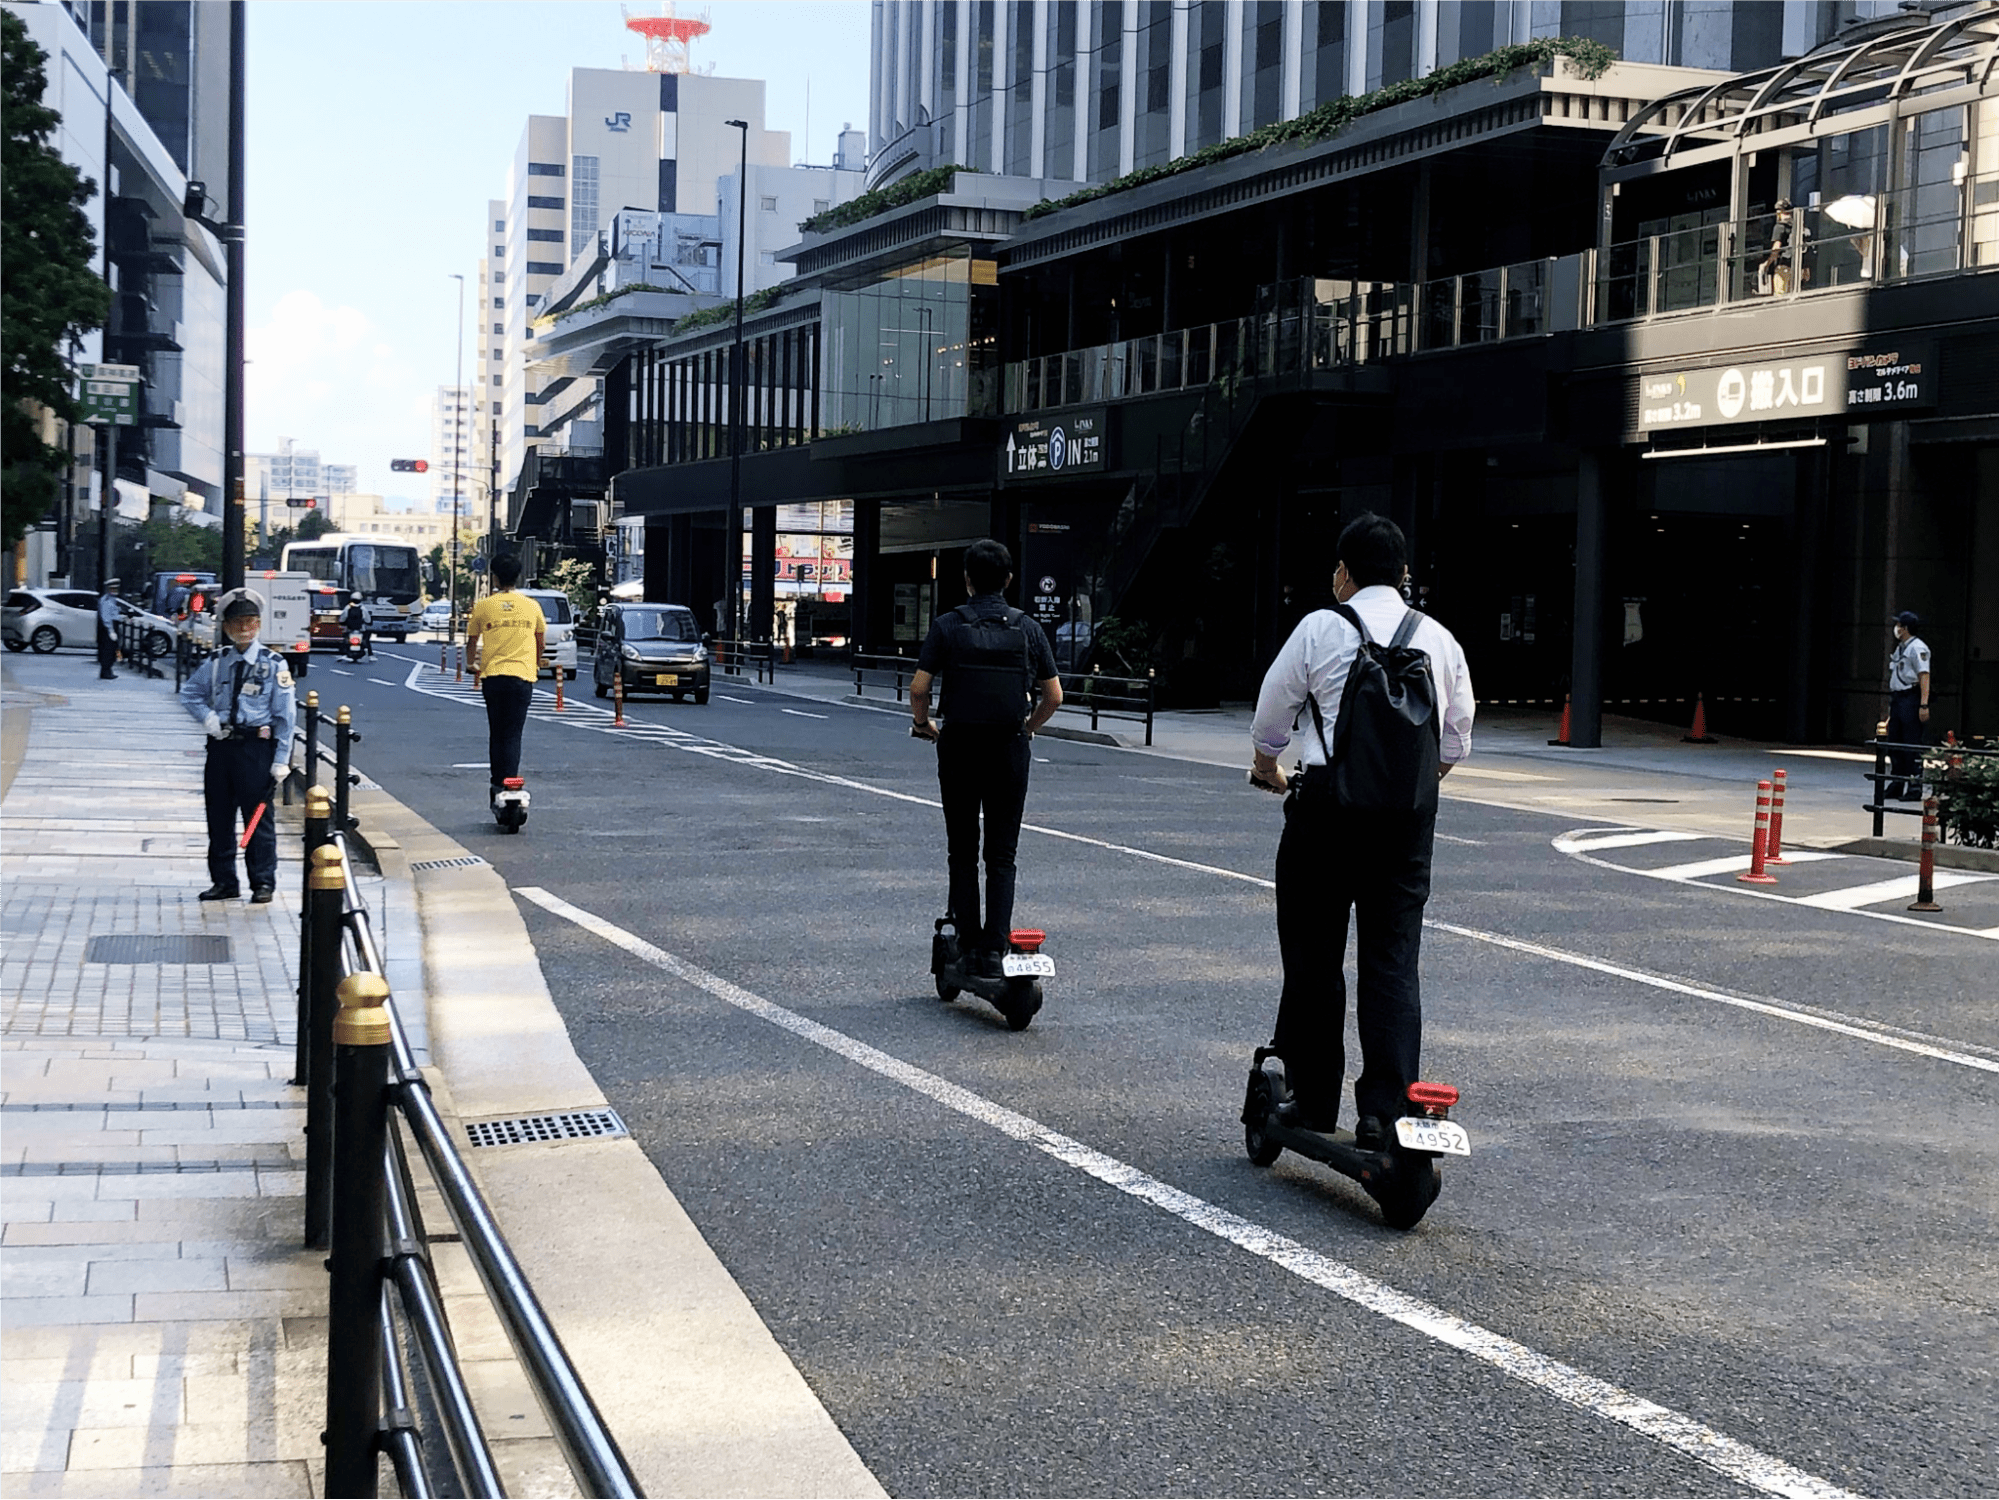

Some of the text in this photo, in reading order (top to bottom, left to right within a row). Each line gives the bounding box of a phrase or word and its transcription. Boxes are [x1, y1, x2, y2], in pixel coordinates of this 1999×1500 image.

[604, 111, 632, 128] JR
[1883, 380, 1918, 402] 3.6m
[1673, 401, 1702, 421] 3.2m
[1017, 444, 1037, 471] 立体
[1067, 438, 1082, 466] IN
[1016, 961, 1051, 973] 4855
[1416, 1132, 1465, 1152] 4952
